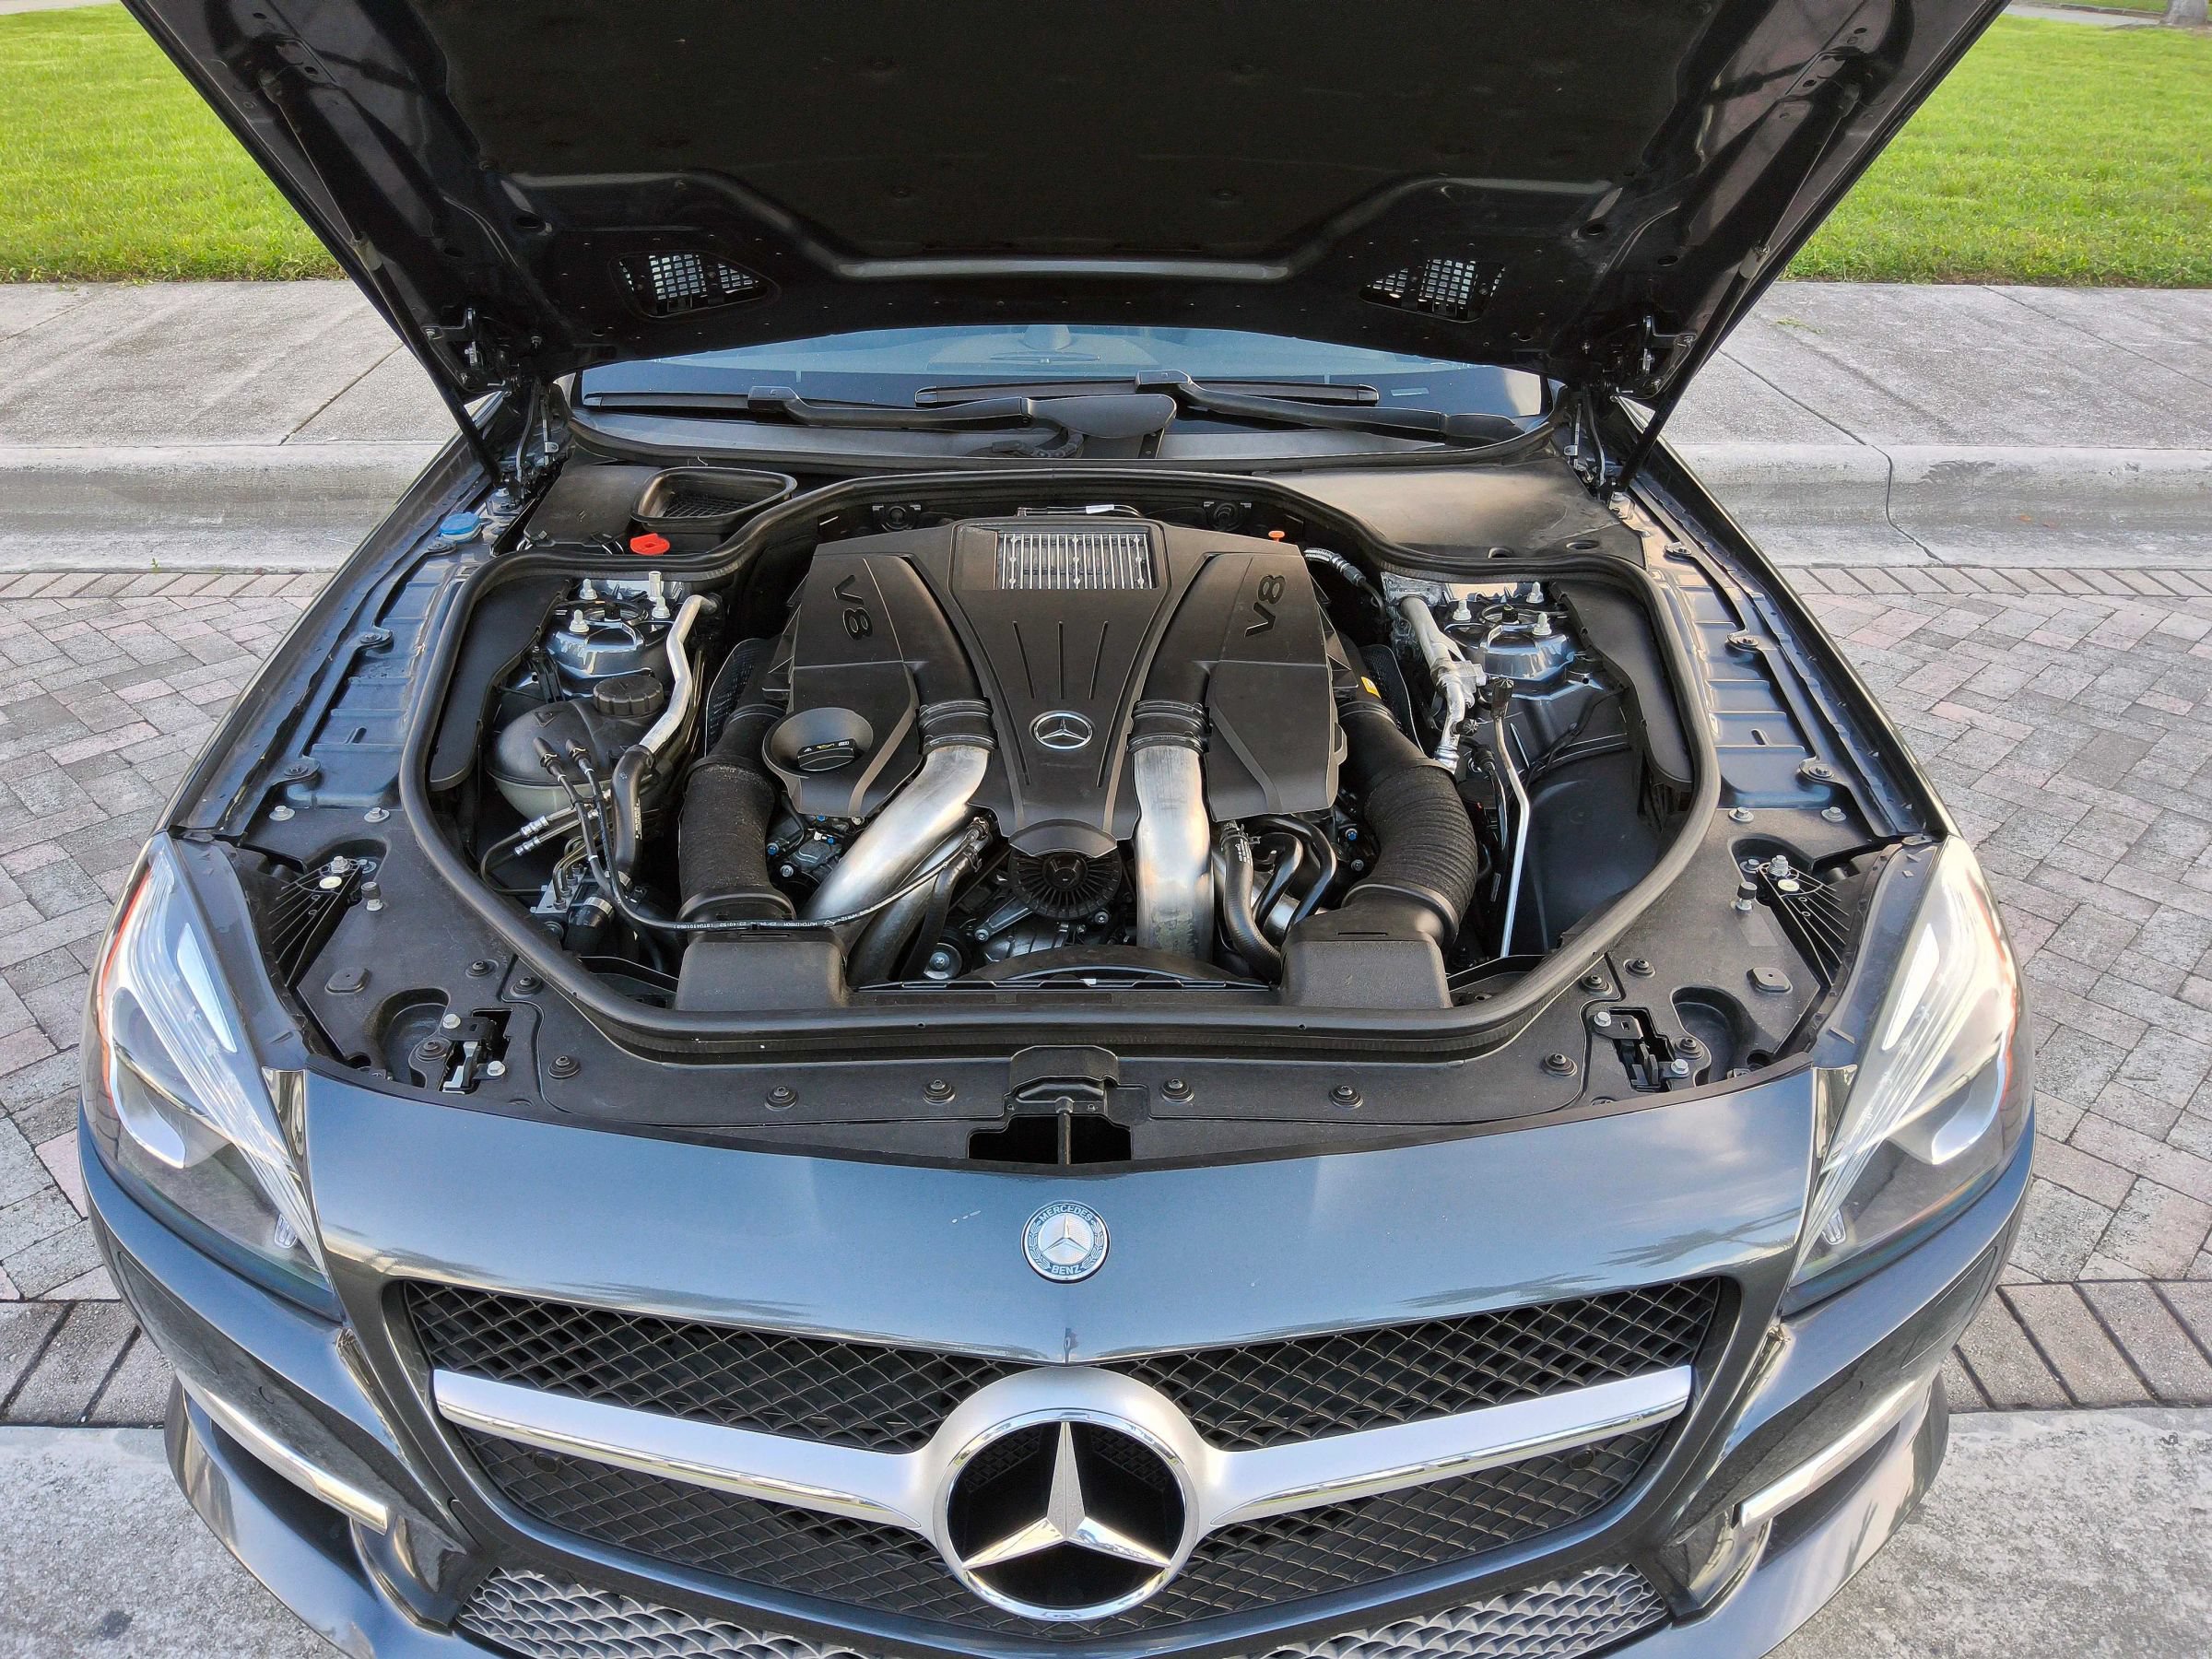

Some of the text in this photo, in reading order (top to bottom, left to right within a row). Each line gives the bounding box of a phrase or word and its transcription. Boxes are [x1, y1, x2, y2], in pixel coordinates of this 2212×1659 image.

[832, 574, 873, 641] V8
[1244, 575, 1286, 638] V8
[1039, 1205, 1094, 1222] MERCEDES
[1051, 1265, 1082, 1276] BENZ
